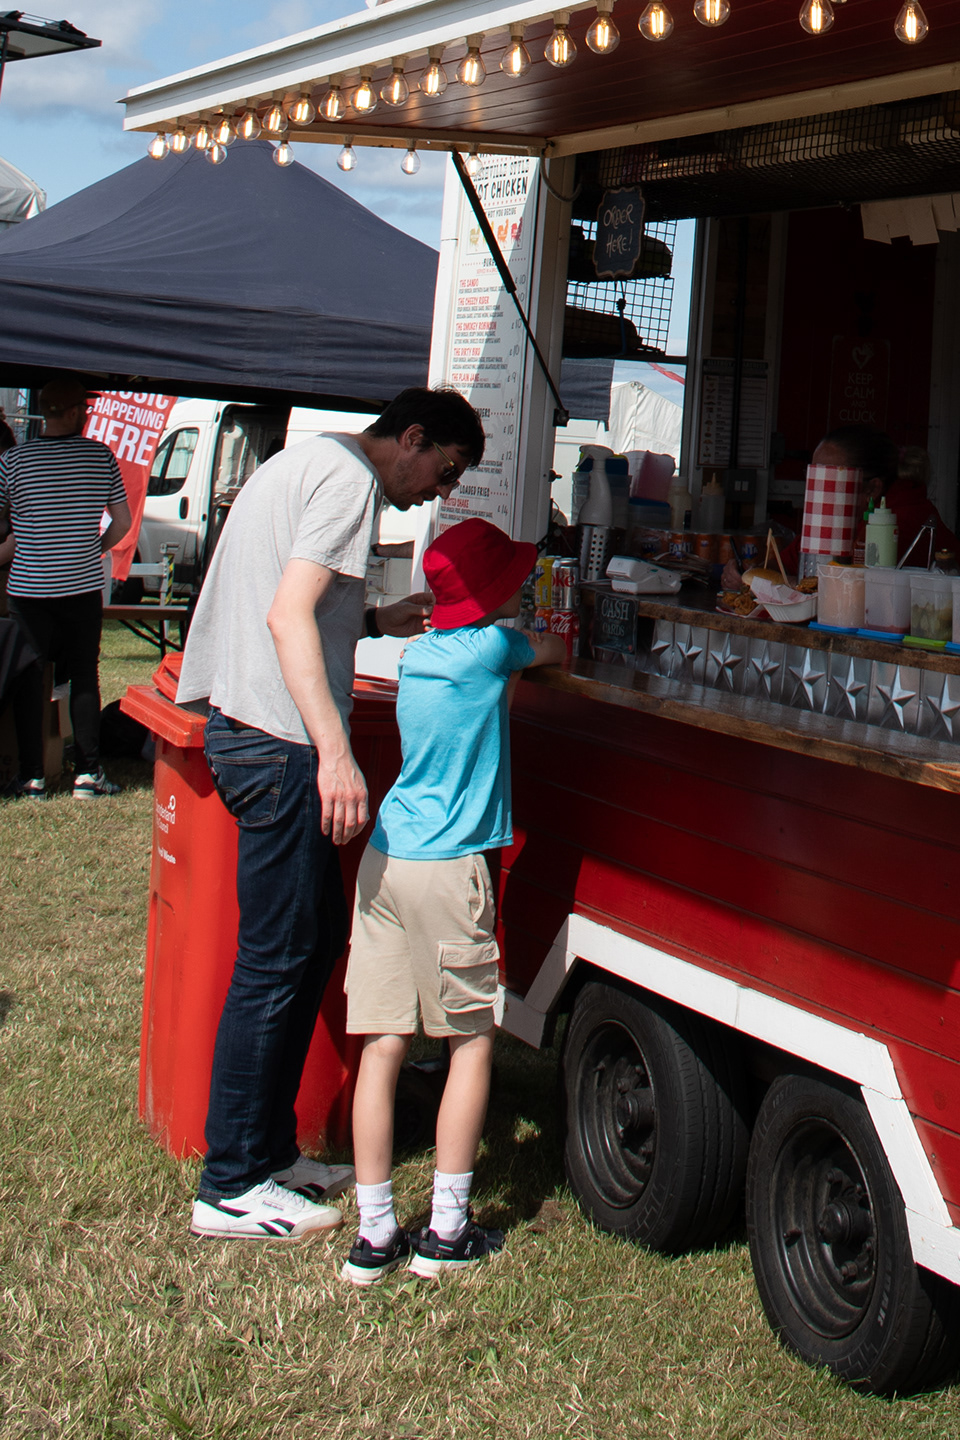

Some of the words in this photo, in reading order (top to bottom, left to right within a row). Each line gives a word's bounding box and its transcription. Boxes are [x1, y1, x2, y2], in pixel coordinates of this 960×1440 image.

[510, 159, 529, 175] STYLE
[491, 176, 528, 199] CHICKEN
[603, 203, 634, 229] ORDER
[606, 228, 633, 258] HERE!
[848, 372, 873, 385] KEEP
[844, 386, 875, 400] CALM
[93, 397, 165, 430] HAPPENING
[839, 409, 876, 424] CLUCK
[86, 415, 160, 467] HERE
[601, 598, 630, 621] CASH
[602, 623, 625, 637] CARDS
